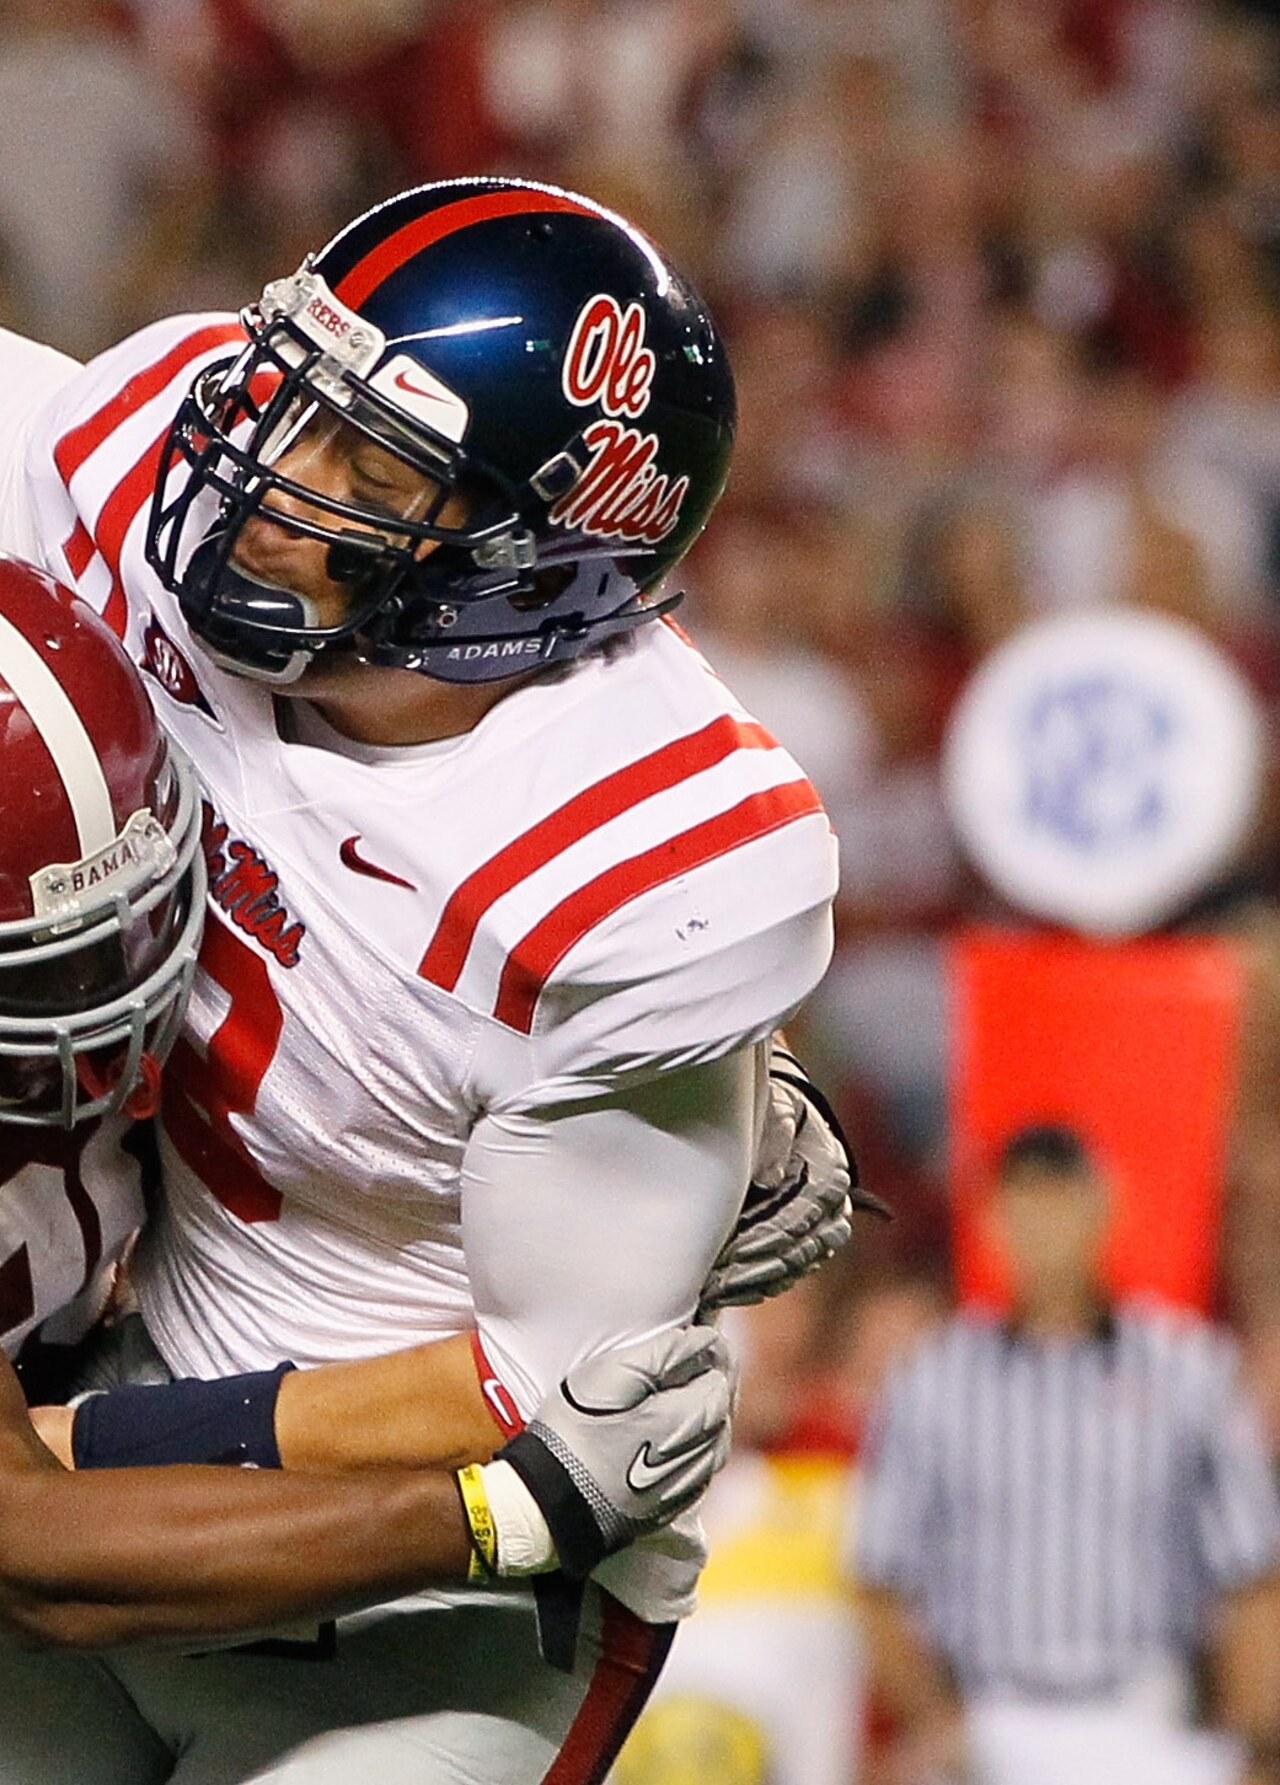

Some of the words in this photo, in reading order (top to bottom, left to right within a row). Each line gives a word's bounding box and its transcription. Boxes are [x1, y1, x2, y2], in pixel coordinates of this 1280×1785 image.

[306, 297, 352, 338] REBS
[562, 293, 656, 419] Ole
[548, 418, 690, 544] Miss
[446, 638, 542, 661] ADAMS
[72, 841, 133, 892] BAMA
[212, 840, 306, 969] Miss
